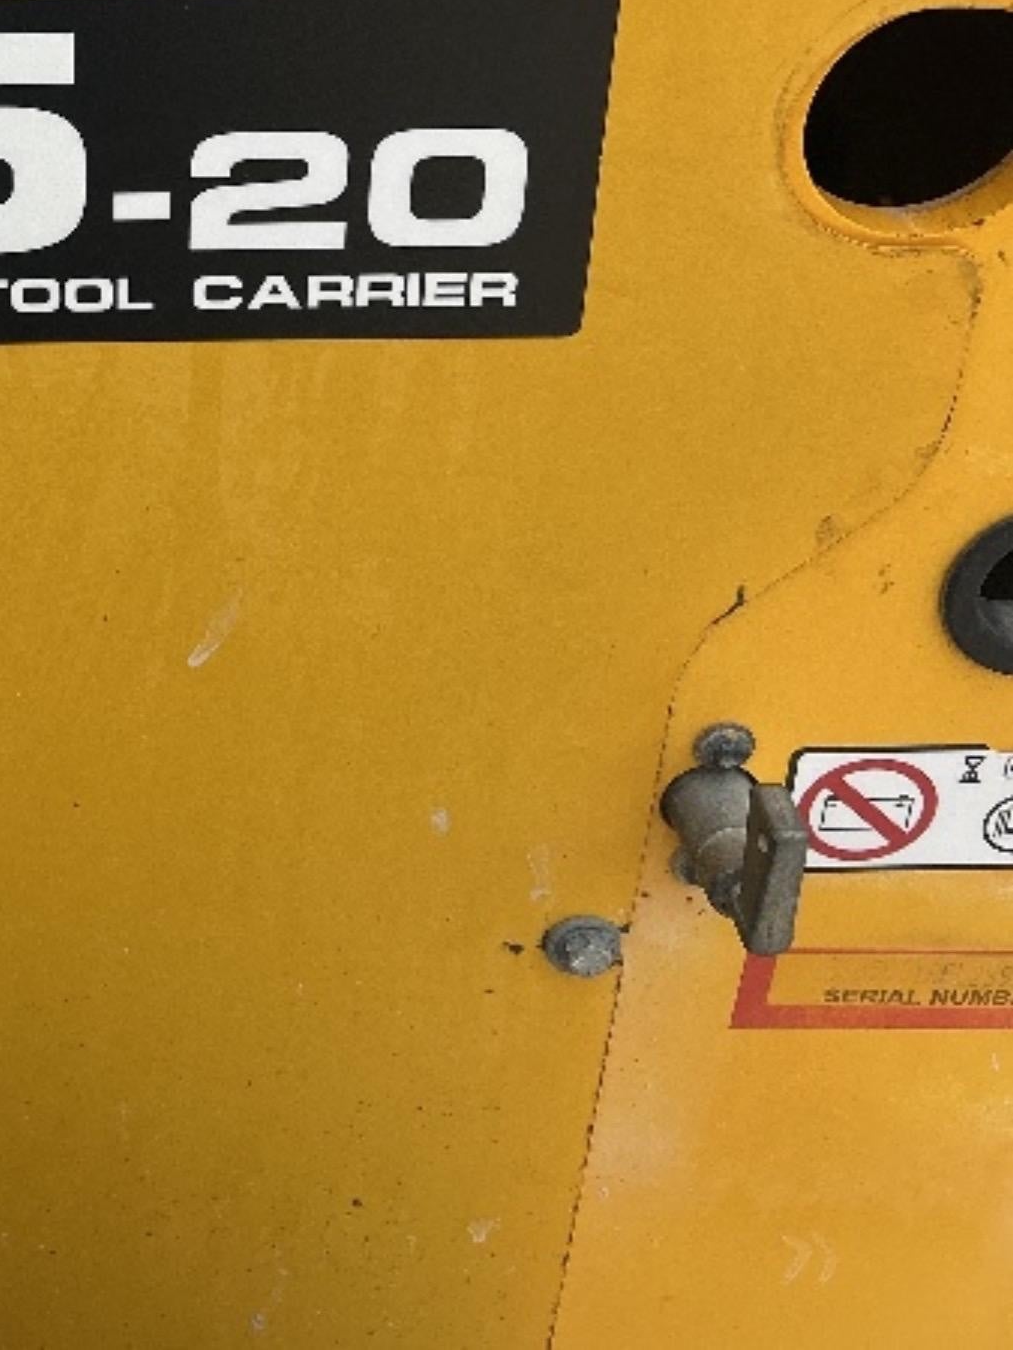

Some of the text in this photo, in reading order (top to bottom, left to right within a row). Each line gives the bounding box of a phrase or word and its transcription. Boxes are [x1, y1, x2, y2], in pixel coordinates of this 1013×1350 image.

[192, 271, 520, 311] CARRIER
[824, 988, 1013, 1007] SERIAL NUMB
